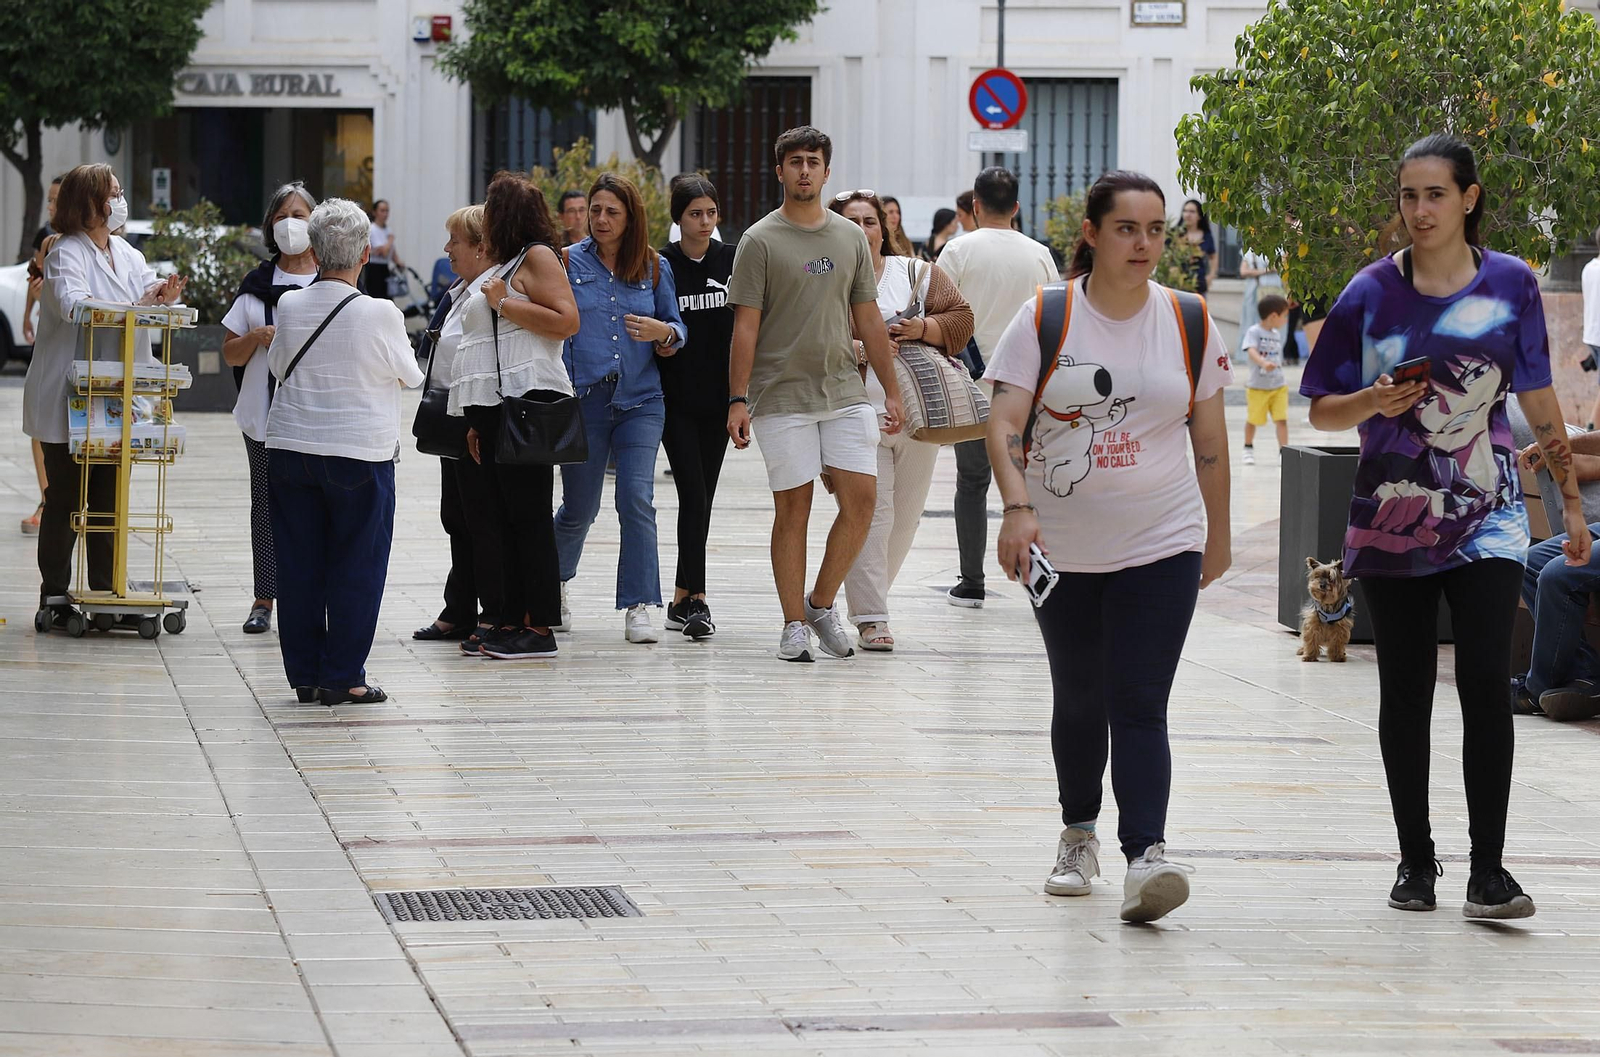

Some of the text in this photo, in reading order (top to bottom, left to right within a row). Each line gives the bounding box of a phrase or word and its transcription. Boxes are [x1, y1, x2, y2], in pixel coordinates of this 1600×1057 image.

[250, 74, 341, 96] RURAL
[679, 292, 724, 311] PUMA
[1103, 432, 1131, 443] I'LL BE
[1093, 445, 1103, 455] ON
[1107, 443, 1125, 455] YOUR
[1097, 454, 1137, 468] NO CALLS.
